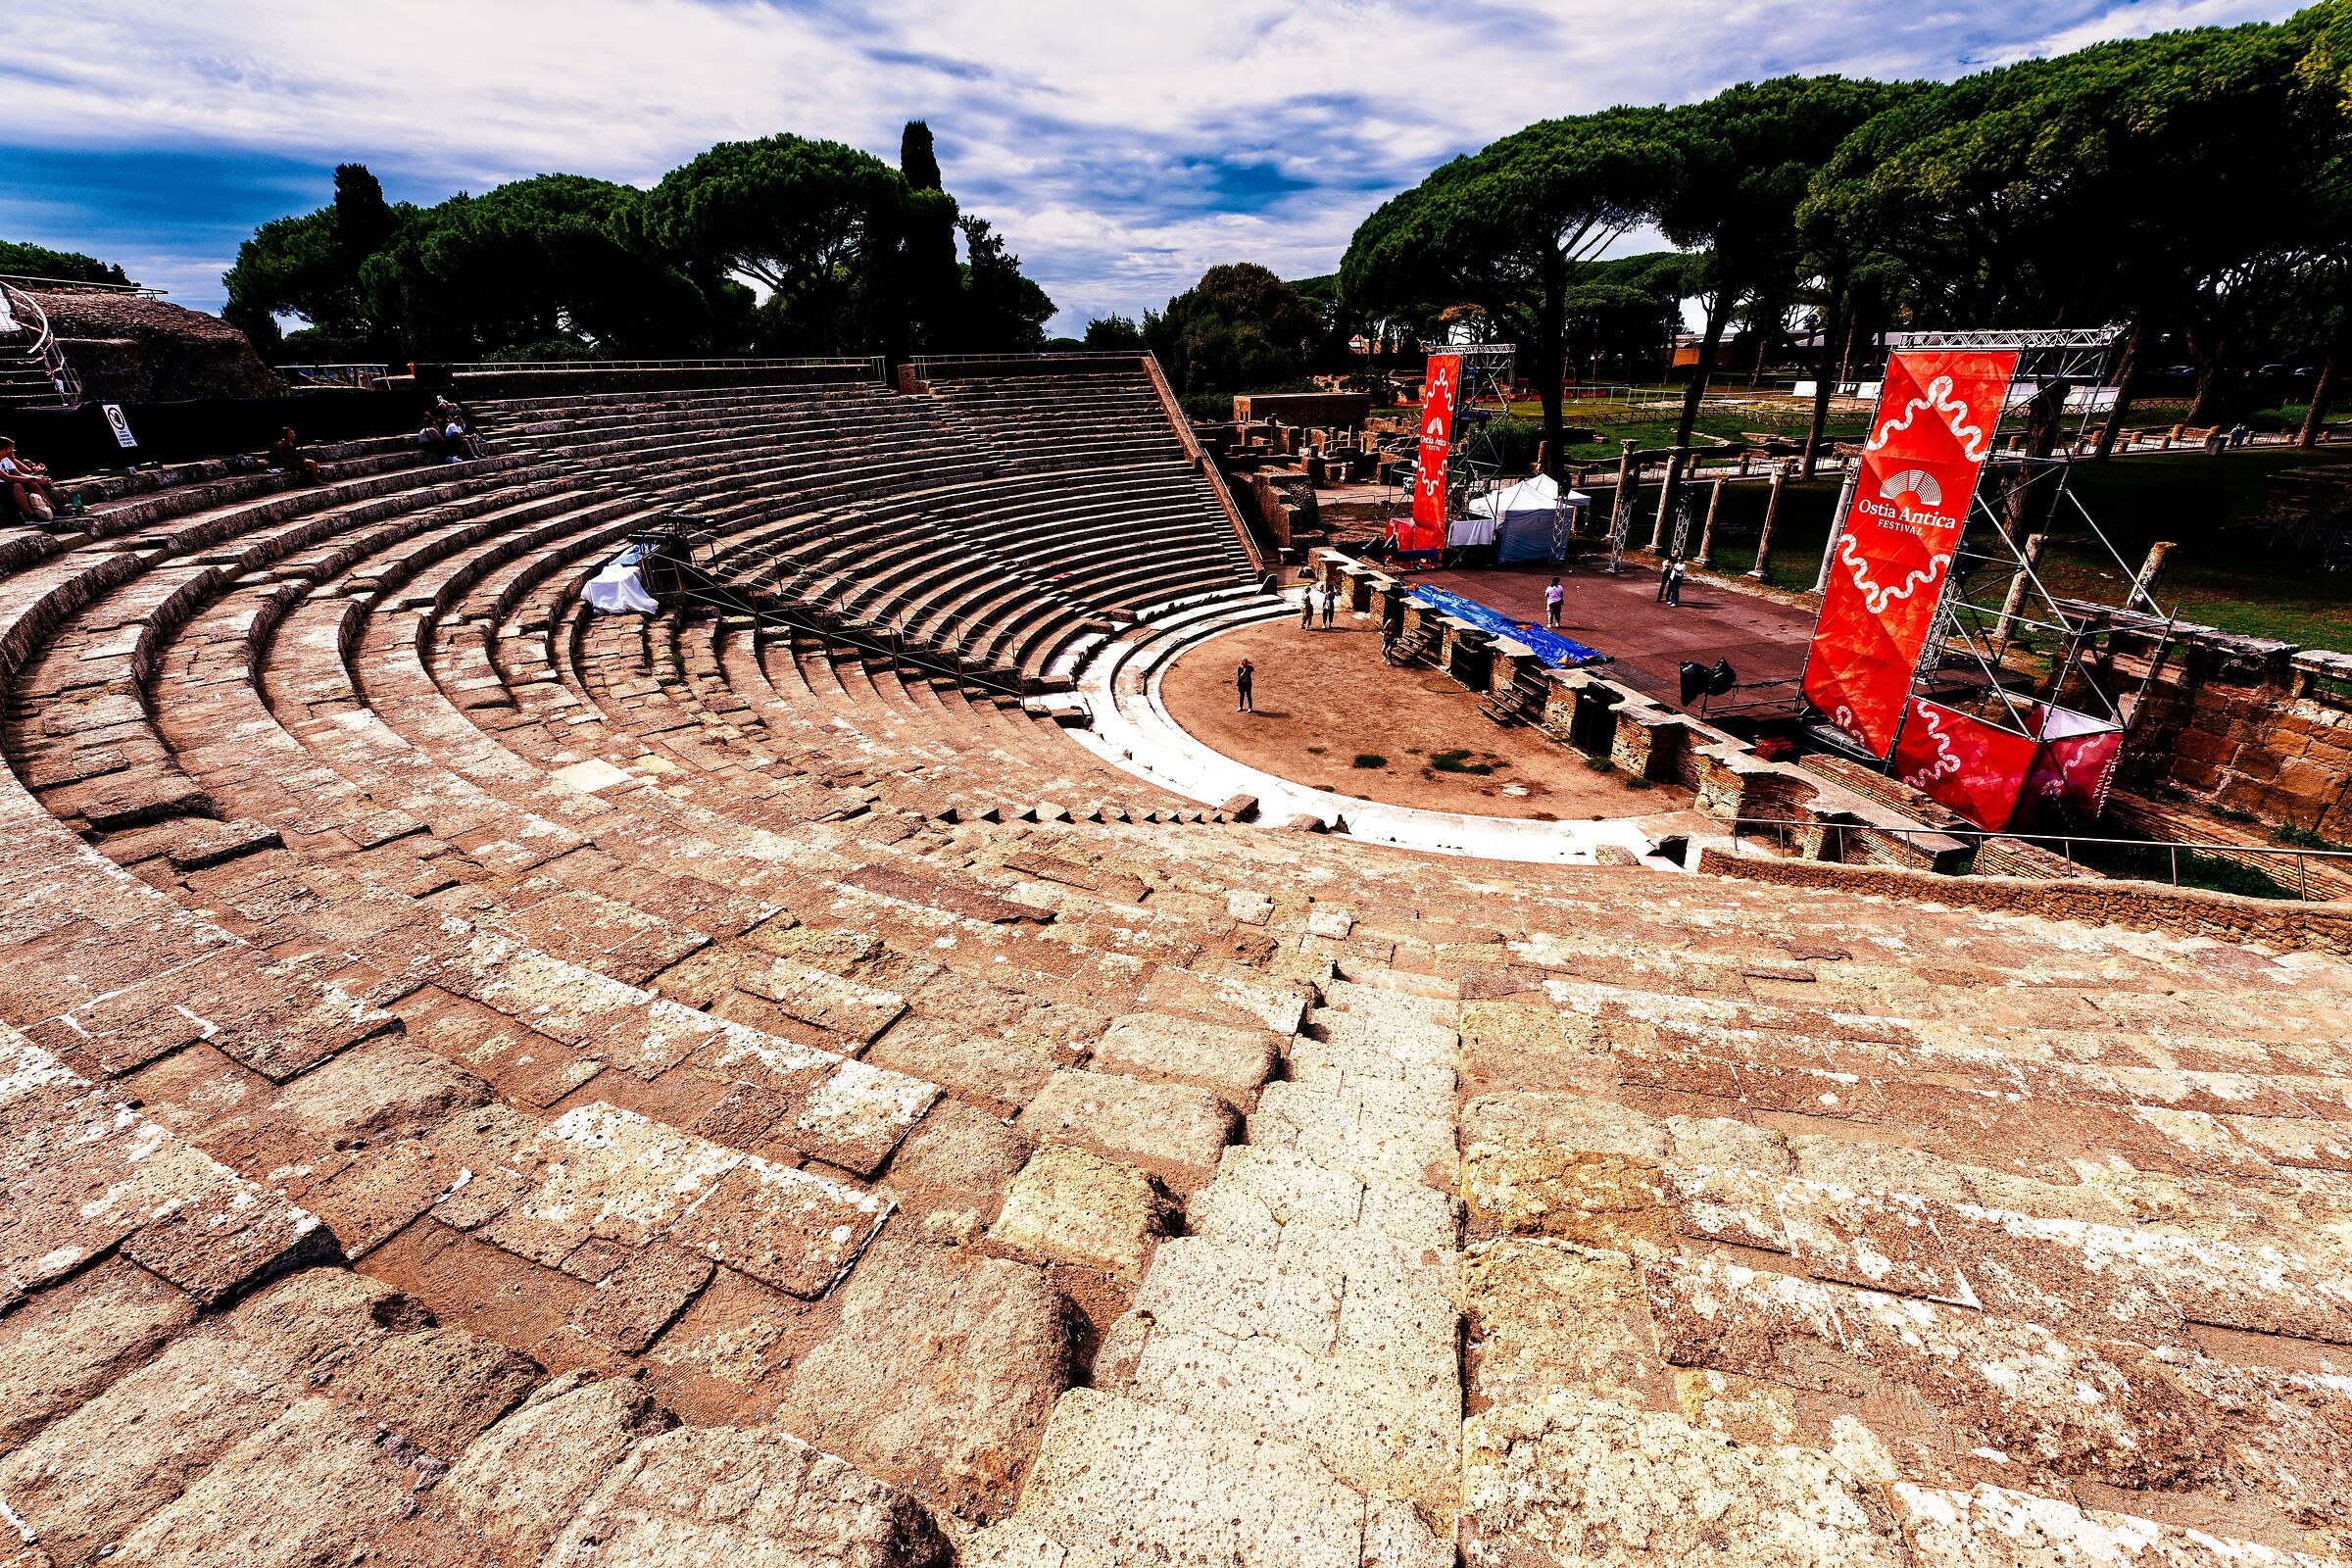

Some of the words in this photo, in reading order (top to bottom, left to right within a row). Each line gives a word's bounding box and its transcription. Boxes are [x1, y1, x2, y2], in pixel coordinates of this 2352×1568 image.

[1858, 499, 1896, 518] Ostia
[1898, 507, 1956, 529] Antica
[1878, 518, 1924, 536] FESTIVAL
